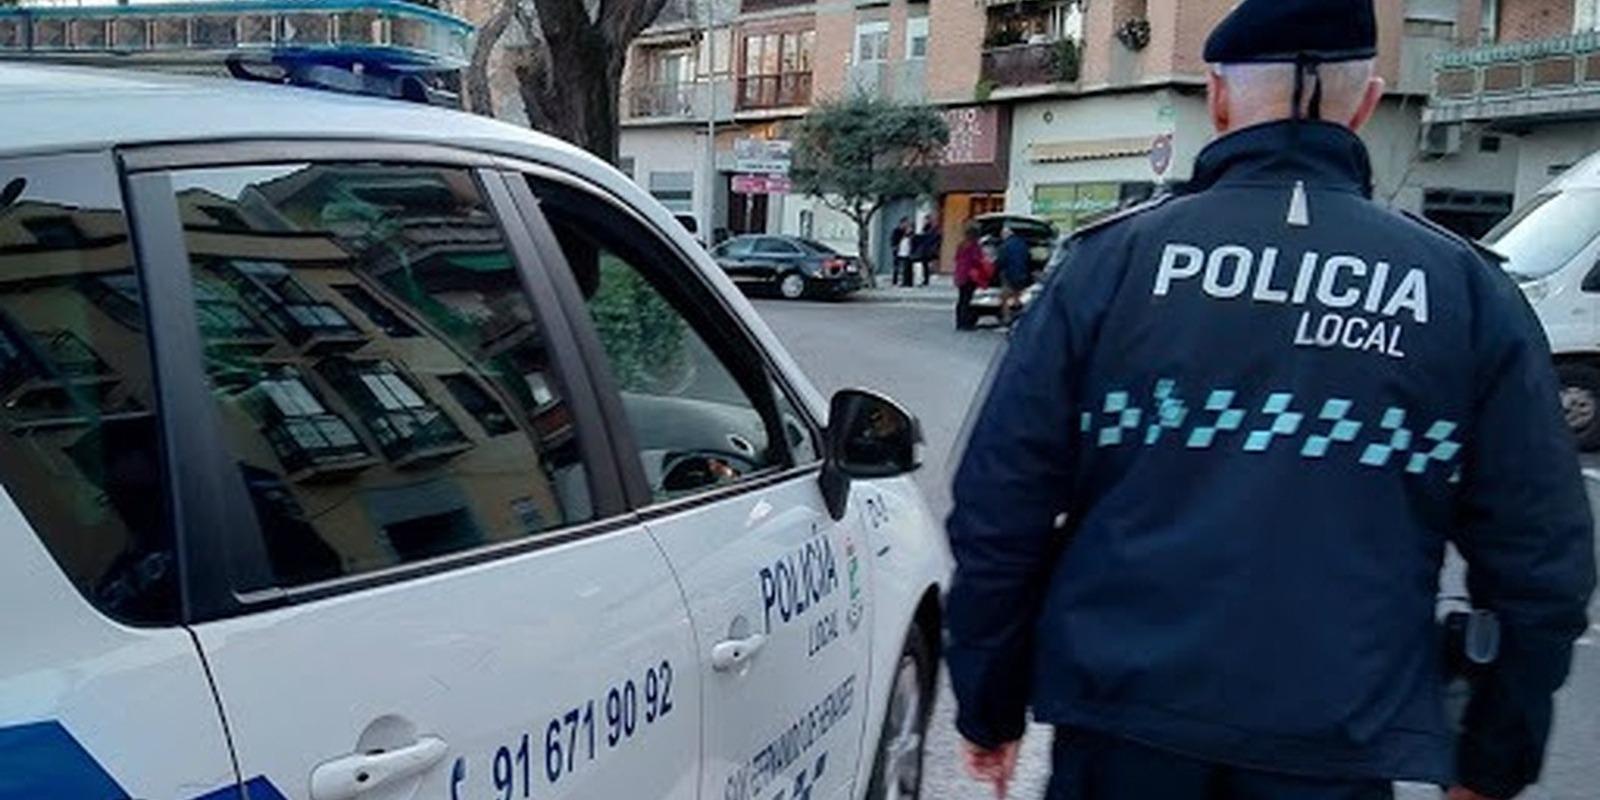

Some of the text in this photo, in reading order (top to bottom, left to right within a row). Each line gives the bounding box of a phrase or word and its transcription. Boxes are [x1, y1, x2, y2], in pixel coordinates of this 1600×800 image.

[1153, 243, 1429, 323] POLICIA
[1294, 311, 1405, 357] LOCAL
[493, 660, 673, 800] 91 671 90 92
